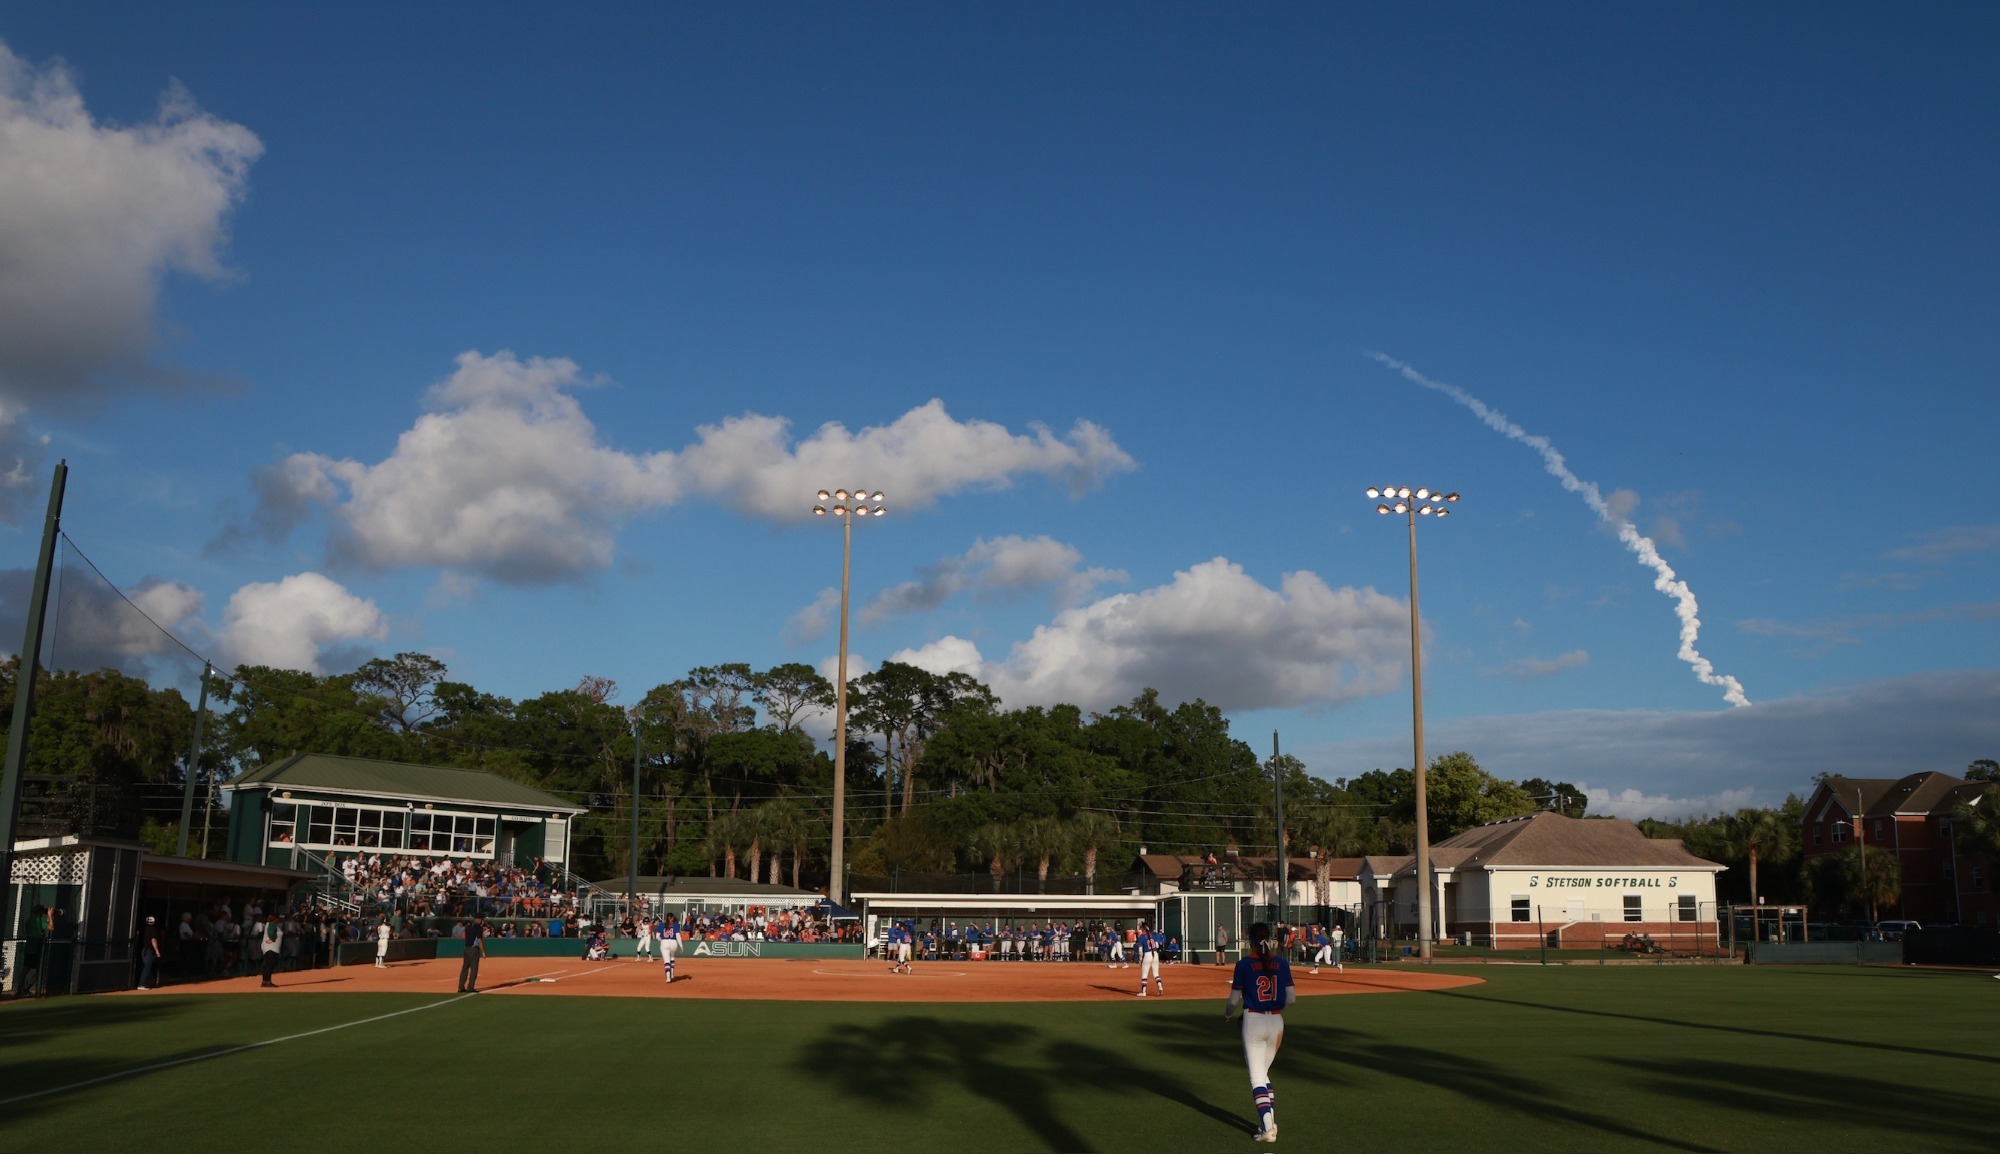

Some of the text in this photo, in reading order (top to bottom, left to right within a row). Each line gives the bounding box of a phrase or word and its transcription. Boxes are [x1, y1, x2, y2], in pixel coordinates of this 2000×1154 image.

[1546, 877, 1661, 888] STETSON SOFTBALL
[693, 941, 761, 956] ASUN
[1256, 975, 1278, 1002] 21
